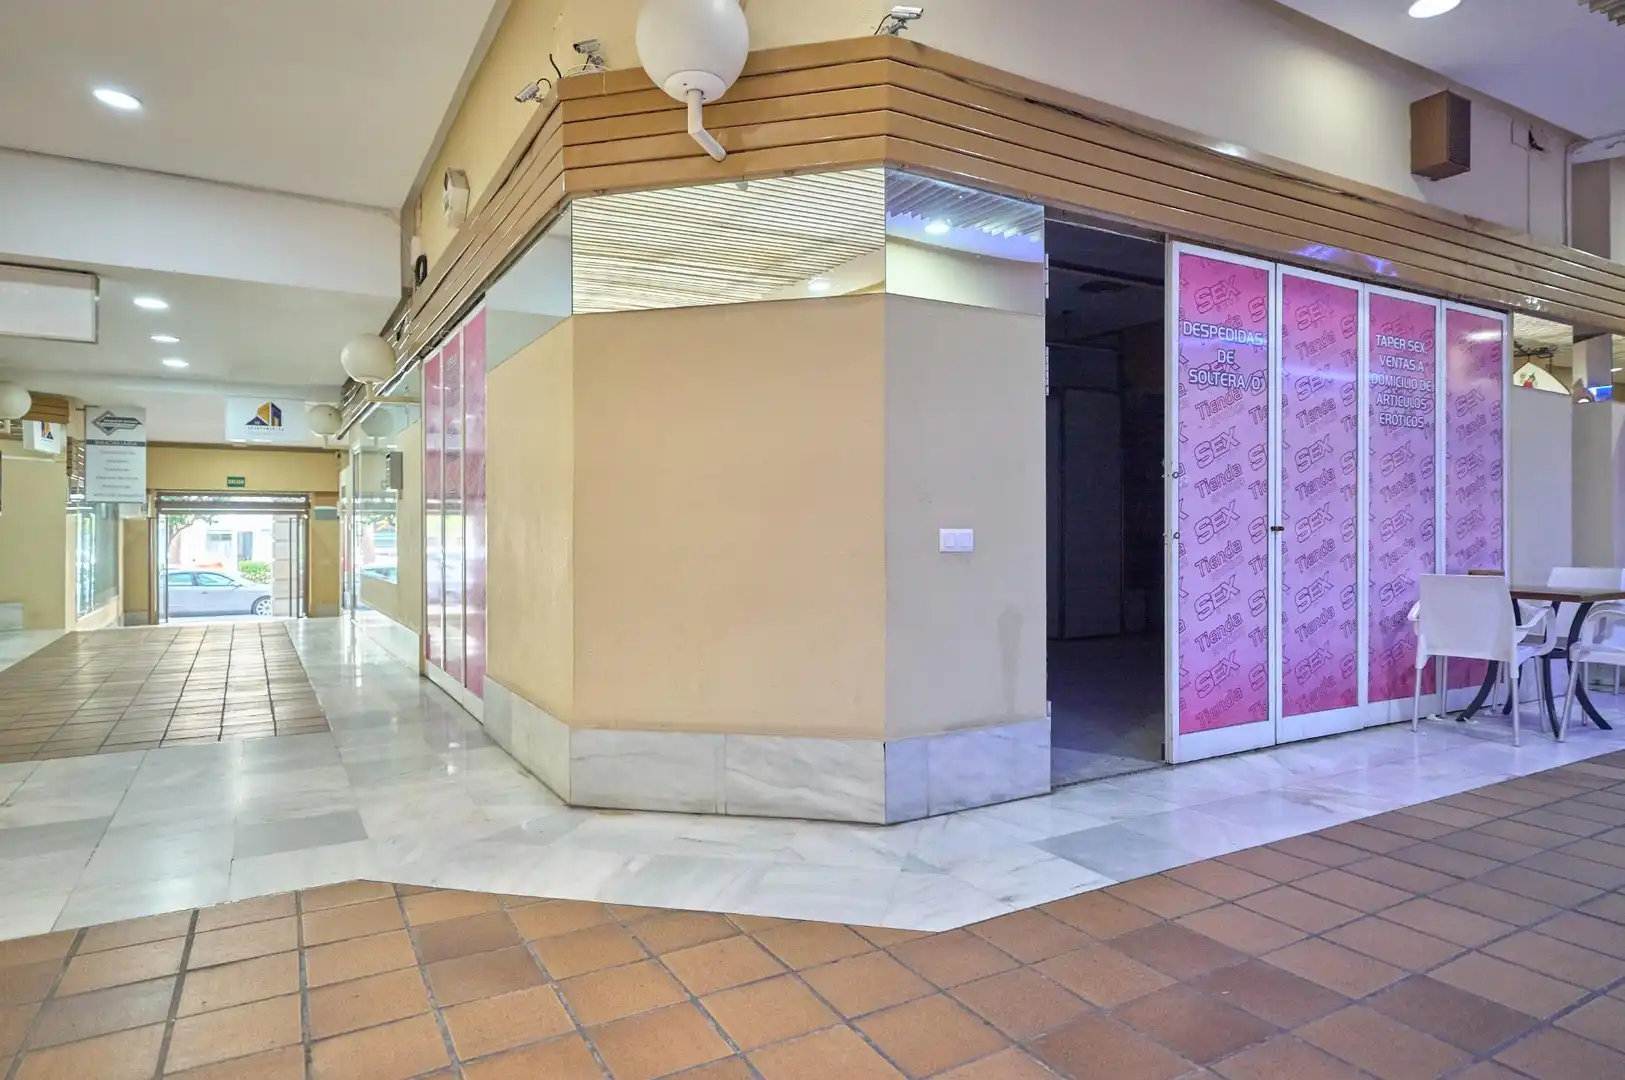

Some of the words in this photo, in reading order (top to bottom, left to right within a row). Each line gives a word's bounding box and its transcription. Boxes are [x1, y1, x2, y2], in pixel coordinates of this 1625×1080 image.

[1194, 274, 1241, 314] SEX
[1295, 293, 1334, 331] SEX
[1183, 321, 1265, 346] DESPEDIDAS
[1376, 334, 1406, 350] TAPER
[1217, 349, 1235, 364] DE
[1380, 354, 1416, 371] VENTAS
[1417, 360, 1425, 372] A
[1189, 369, 1261, 391] SOLTERA/O
[1371, 373, 1418, 390] DOMICILIO
[1419, 379, 1432, 392] DE
[1295, 398, 1336, 429] Tienda
[1380, 412, 1424, 428] EROTICOS
[1194, 425, 1241, 469] SEX
[1295, 433, 1334, 474] SEX
[1380, 440, 1415, 477] SEX
[1194, 463, 1243, 499] Tienda
[1295, 468, 1336, 501] Tienda
[1194, 499, 1241, 545] SEX
[1295, 501, 1334, 544] SEX
[1380, 504, 1415, 543] SEX
[1194, 539, 1243, 578] Tienda
[1295, 538, 1336, 574] Tienda
[1194, 574, 1241, 621] SEX
[1295, 570, 1334, 615] SEX
[1380, 567, 1415, 607] SEX
[1194, 612, 1243, 653] Tienda
[1295, 606, 1336, 642] Tienda
[1194, 649, 1241, 699] SEX
[1295, 640, 1334, 686] SEX
[1195, 687, 1243, 729] Tienda
